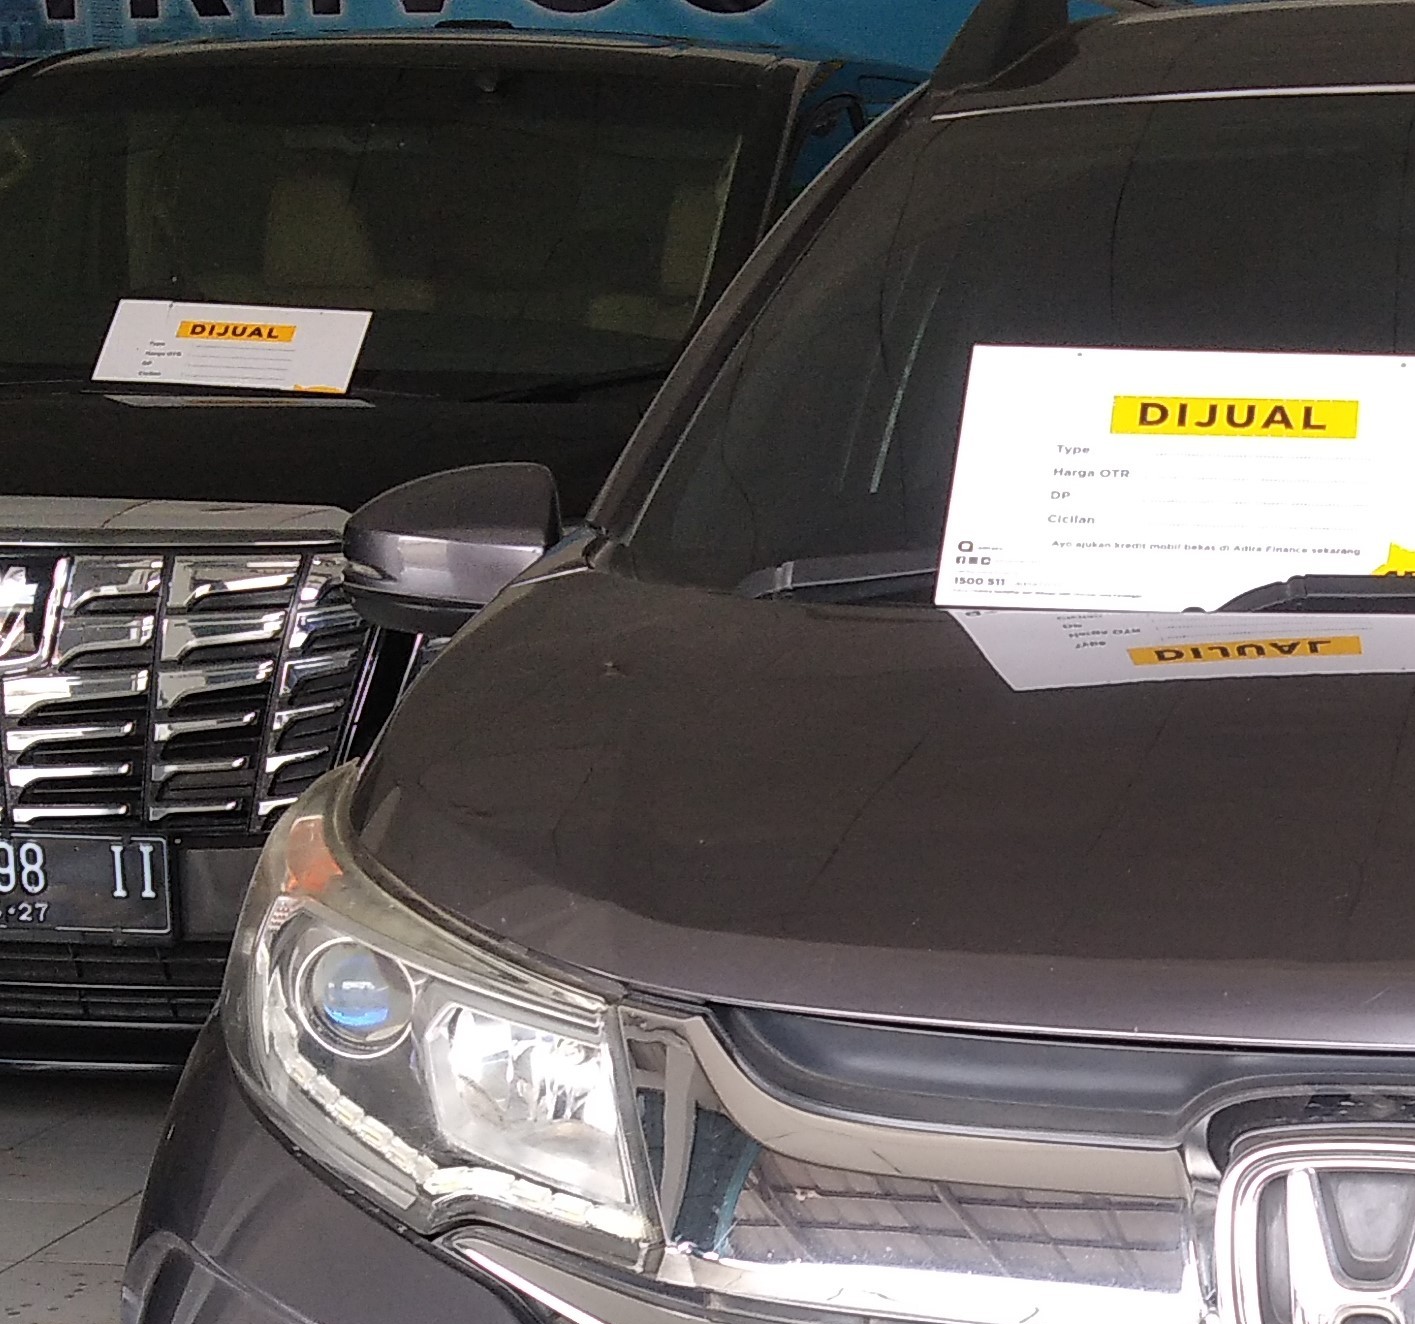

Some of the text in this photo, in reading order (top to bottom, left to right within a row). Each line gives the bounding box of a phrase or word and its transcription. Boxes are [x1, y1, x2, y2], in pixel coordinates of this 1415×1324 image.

[190, 323, 280, 340] DIJUAL
[1138, 401, 1328, 431] DIJUAL
[1056, 444, 1090, 456] Type
[1053, 467, 1130, 479] Harga OTR
[1050, 490, 1071, 500] DP
[1047, 514, 1096, 525] Cicilan
[954, 576, 984, 586] 1500
[987, 577, 1005, 586] 511
[0, 841, 48, 894] 98
